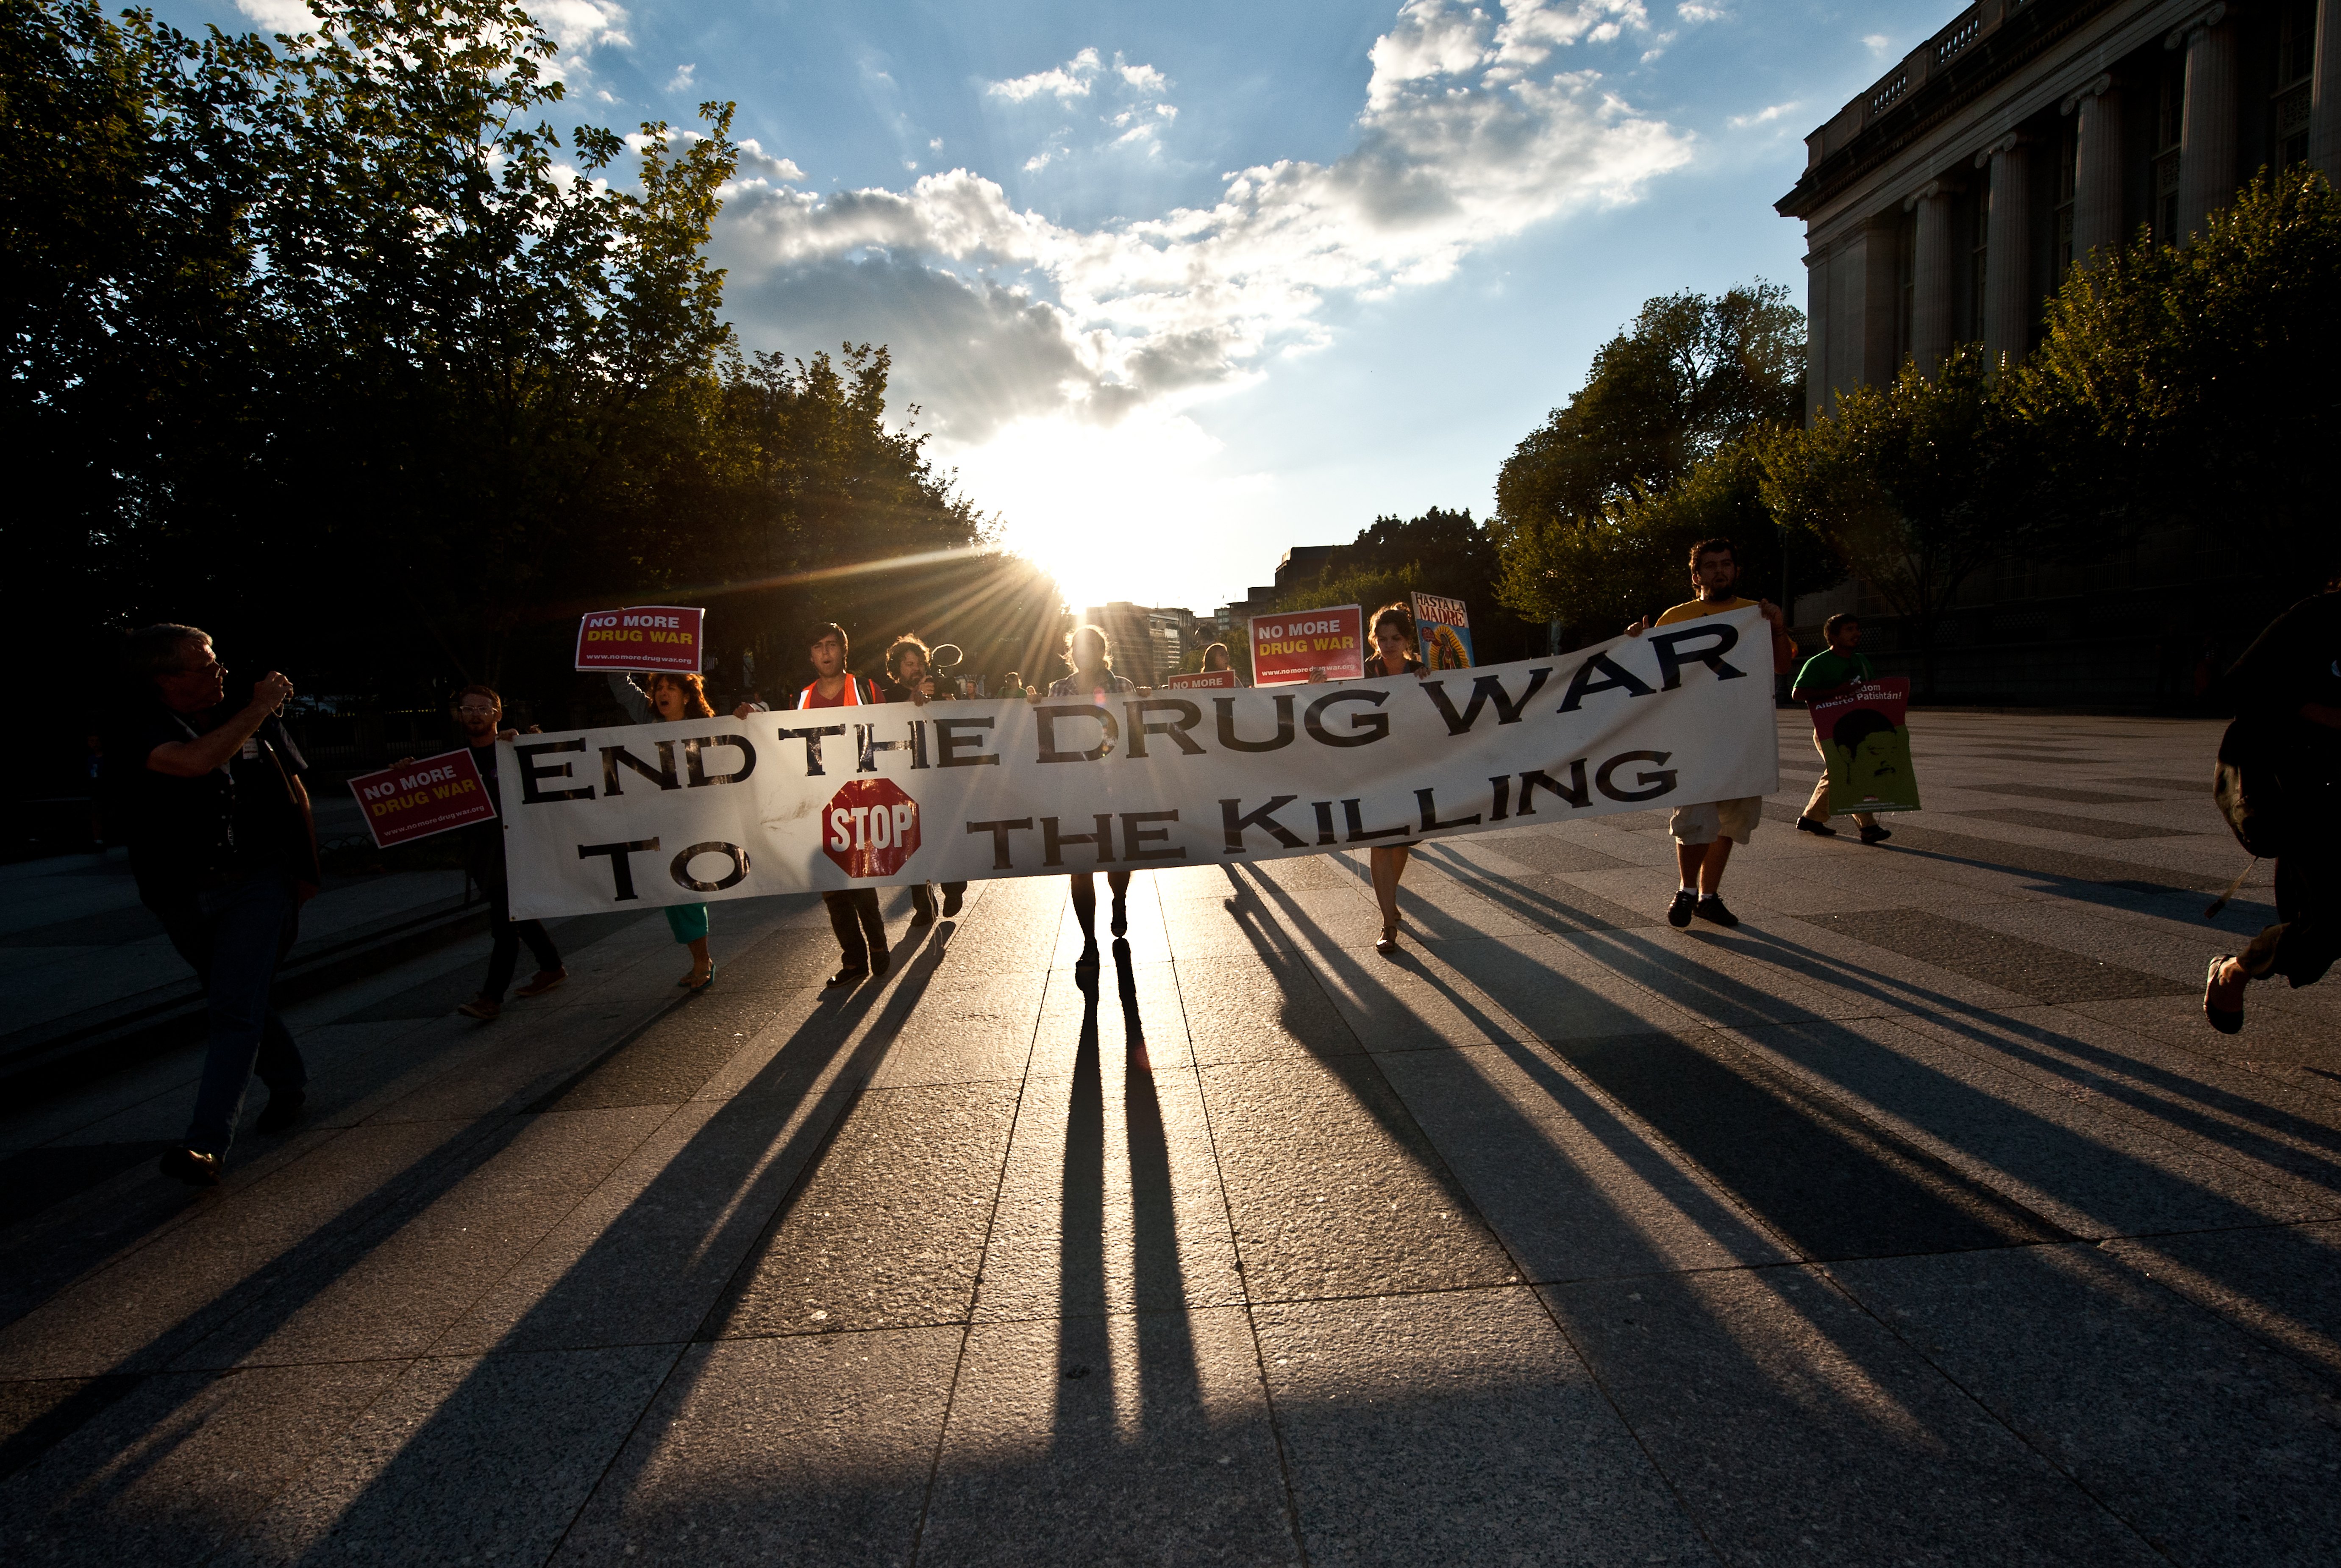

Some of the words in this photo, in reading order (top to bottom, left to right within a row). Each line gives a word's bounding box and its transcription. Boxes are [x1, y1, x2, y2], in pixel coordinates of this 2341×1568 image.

[1415, 593, 1450, 610] HASTA
[1451, 600, 1466, 613] LA
[589, 616, 617, 627] NO
[623, 616, 679, 628] MORE
[1419, 605, 1465, 627] MADRE
[587, 630, 643, 641] DRUG
[650, 631, 692, 644] WAR
[1259, 625, 1283, 640] NO
[1288, 620, 1340, 636] MORE
[1259, 640, 1308, 657] DRUG
[1313, 636, 1354, 651] WAR
[586, 654, 692, 664] www.nomoredrugwar.org
[1173, 681, 1189, 689] NO
[1192, 678, 1223, 688] MORE
[1816, 697, 1854, 710] Alberto
[1856, 691, 1902, 700] Patishtán!
[514, 734, 756, 804] END
[778, 716, 1000, 776] THE
[1033, 690, 1390, 763] DRUG
[1419, 624, 1747, 736] WAR
[364, 782, 395, 800] NO
[400, 765, 457, 791] MORE
[371, 791, 430, 816] DRUG
[432, 779, 477, 800] WAR
[384, 805, 485, 836] www.nomoredrugwar.org
[578, 837, 750, 901] TO
[830, 804, 912, 852] STOP
[967, 809, 1186, 869] THE
[1218, 750, 1677, 854] KILLING
